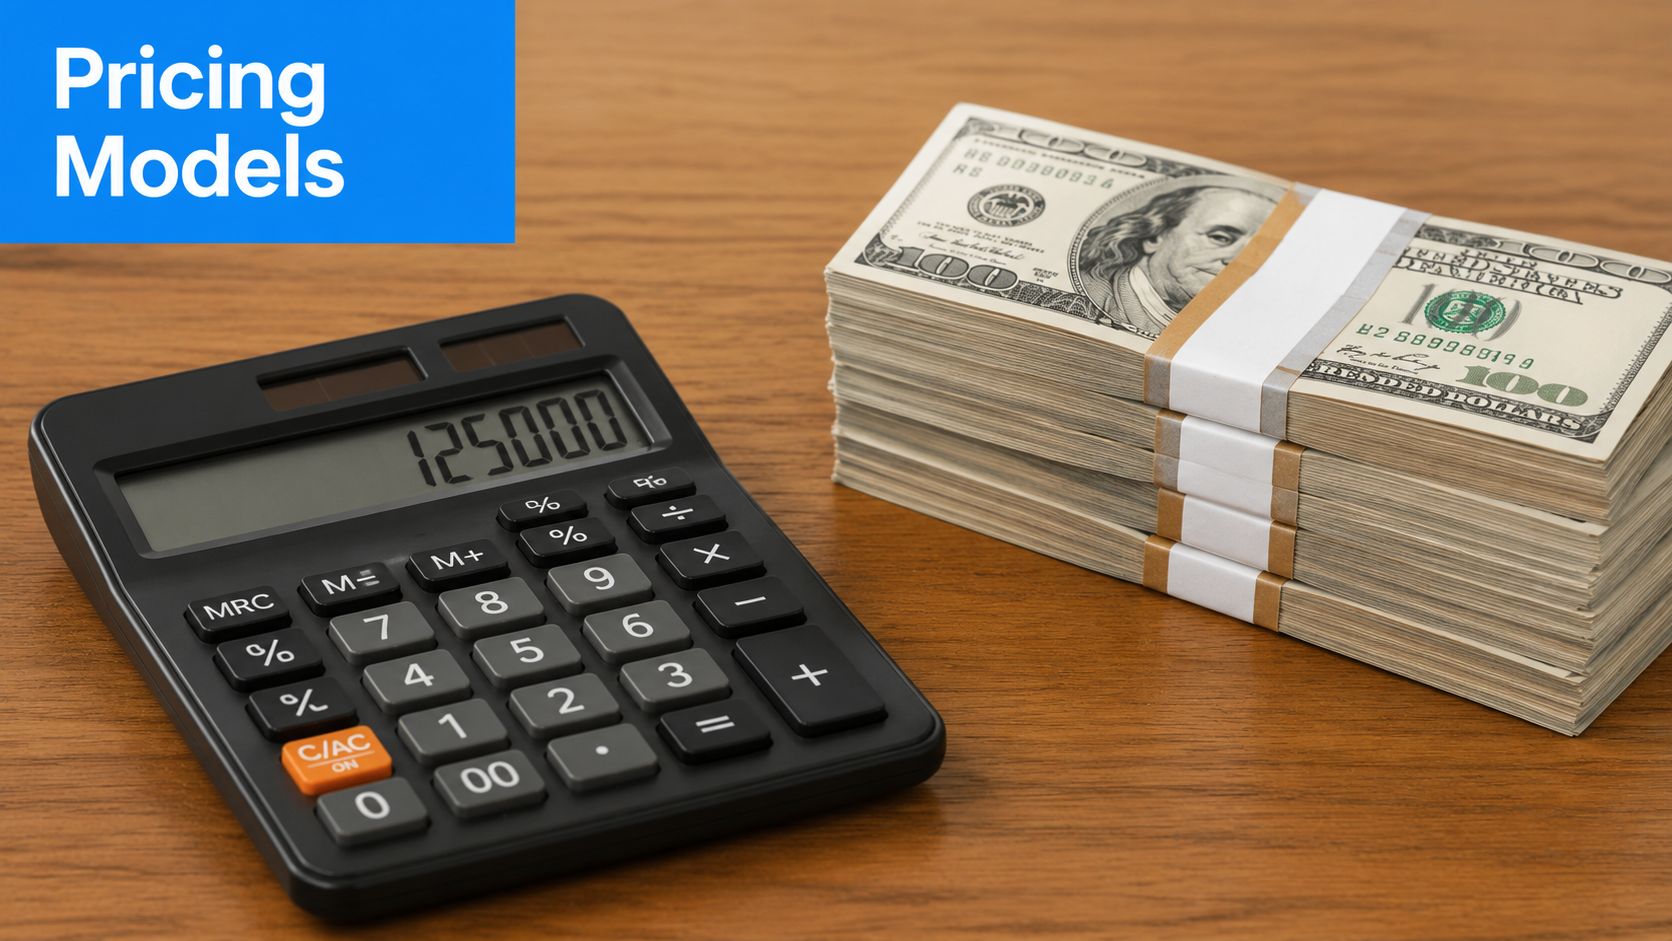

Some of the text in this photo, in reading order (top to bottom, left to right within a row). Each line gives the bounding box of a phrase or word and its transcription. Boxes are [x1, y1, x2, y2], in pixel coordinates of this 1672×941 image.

[890, 246, 1019, 291] 100
[1456, 364, 1589, 408] 100
[407, 389, 628, 487] 125000
[548, 525, 588, 546] %
[430, 549, 484, 570] M+
[583, 566, 615, 591] 9
[203, 593, 275, 620] MRC
[474, 590, 509, 615] 8
[363, 614, 389, 640] 7
[622, 613, 654, 638] 6
[245, 639, 295, 667] %
[509, 637, 544, 663] 5
[404, 663, 434, 687] 4
[657, 662, 693, 688] 3
[547, 687, 585, 714] 2
[438, 713, 467, 739] 1
[297, 733, 372, 762] C/AC
[331, 758, 359, 773] ON
[460, 761, 520, 794] 00
[355, 791, 390, 819] 0
